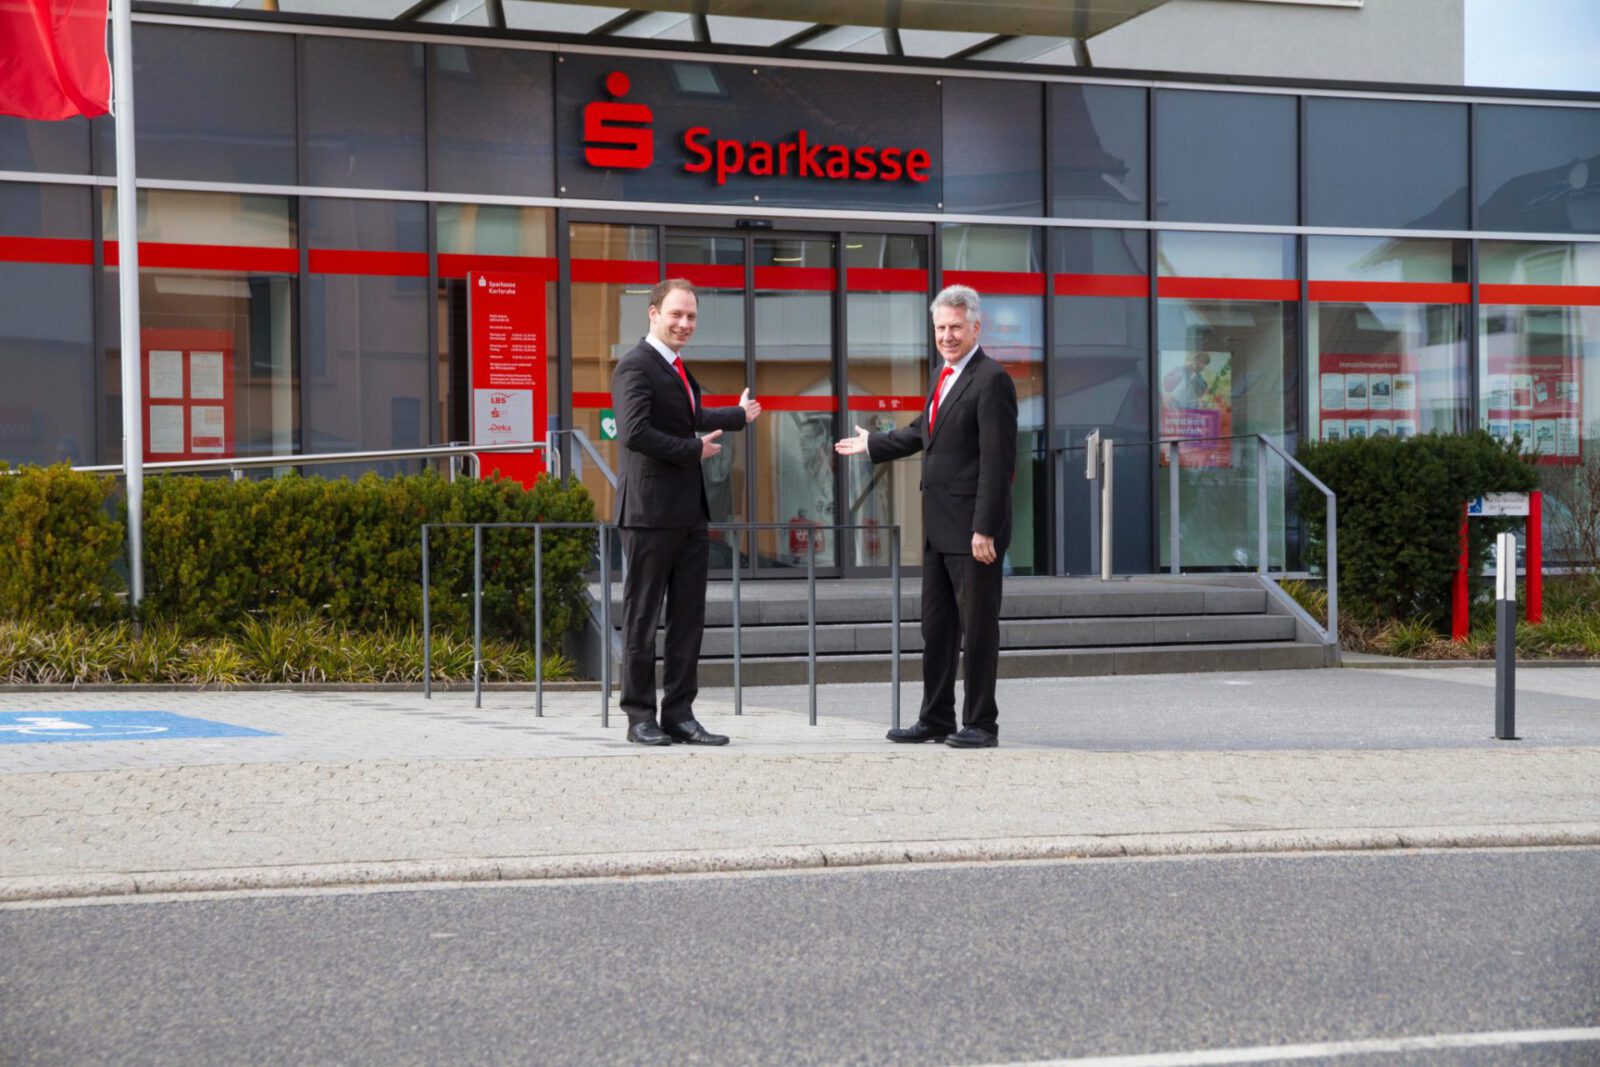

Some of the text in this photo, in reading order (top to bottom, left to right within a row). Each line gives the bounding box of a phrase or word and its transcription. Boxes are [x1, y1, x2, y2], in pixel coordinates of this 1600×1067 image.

[683, 126, 932, 185] Sparkasse
[488, 281, 516, 289] Sparkasse
[491, 396, 506, 404] LBS
[490, 423, 512, 432] Deka
